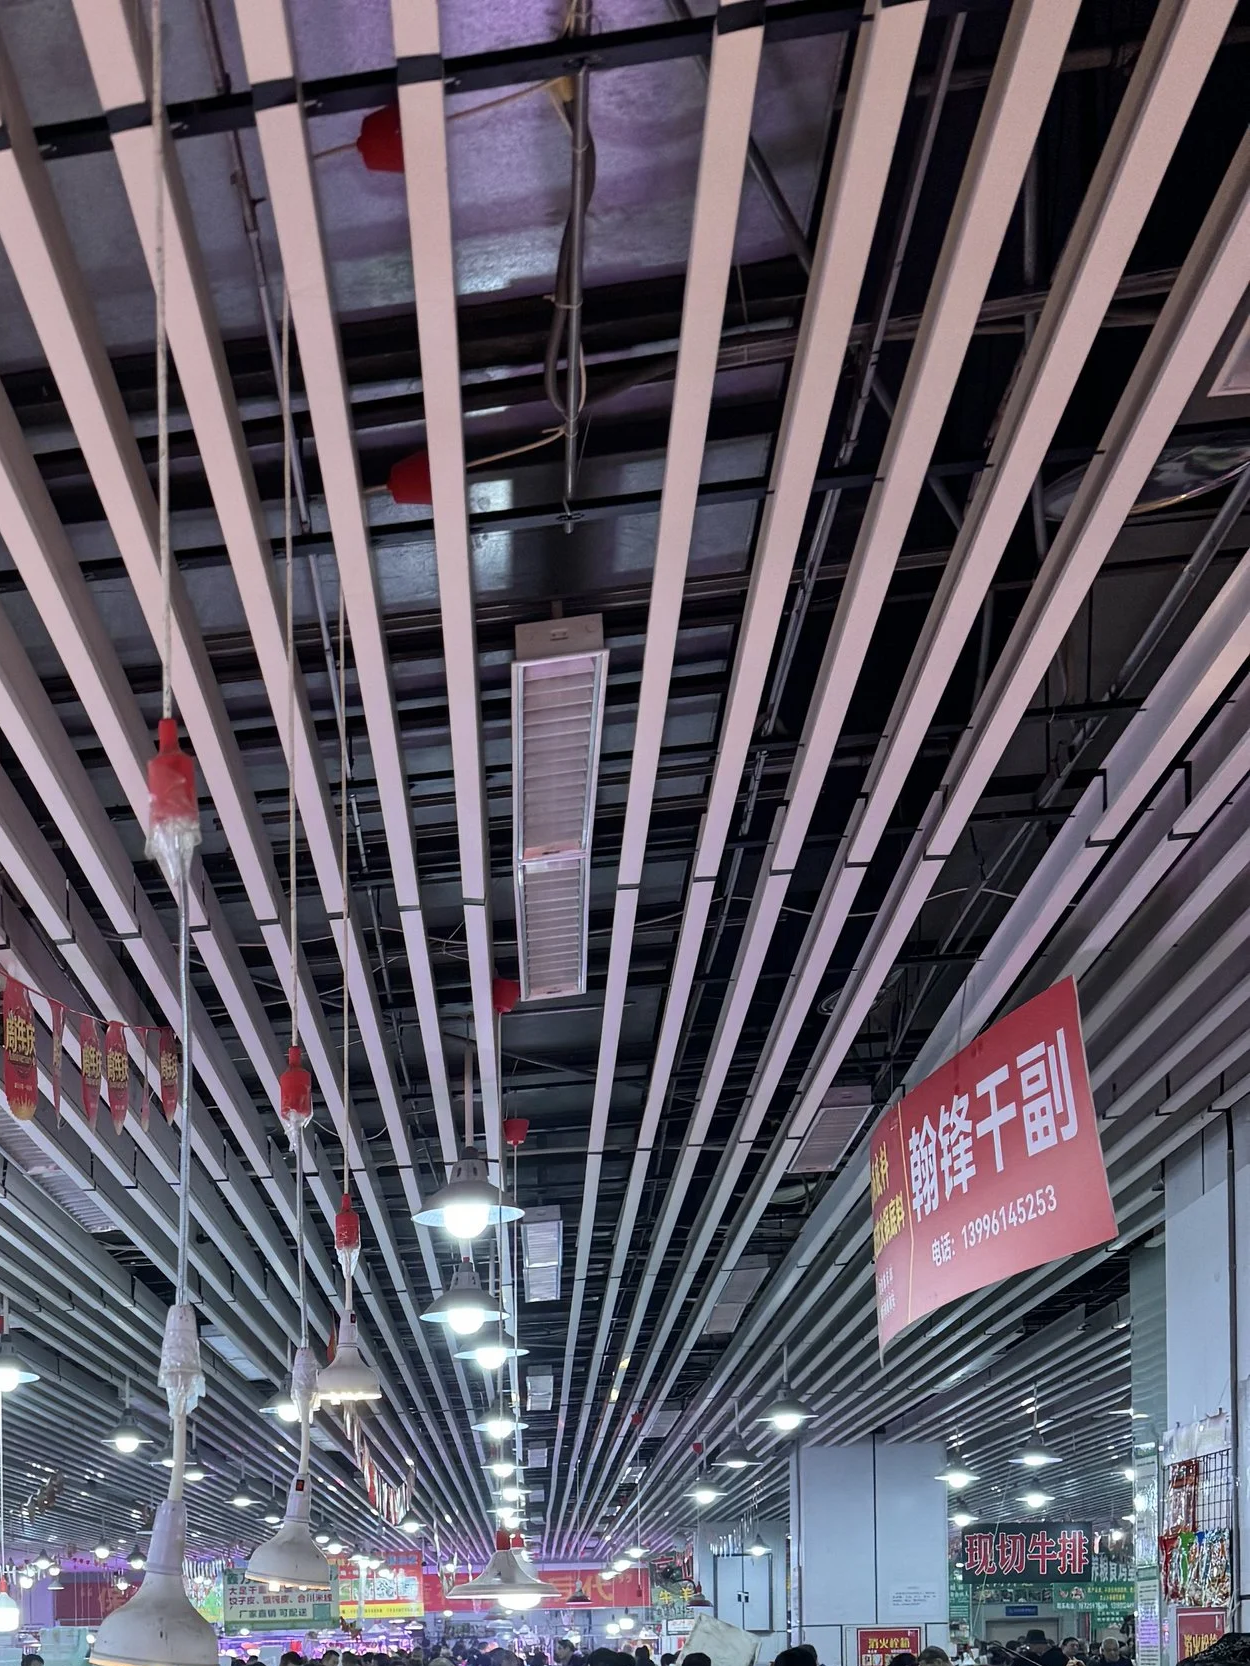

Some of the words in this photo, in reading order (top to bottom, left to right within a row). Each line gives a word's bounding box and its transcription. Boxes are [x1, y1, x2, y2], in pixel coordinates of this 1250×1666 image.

[908, 1026, 1079, 1223] 翰锋干副
[961, 1183, 1058, 1250] 13996145253
[964, 1529, 1090, 1575] 现切牛排
